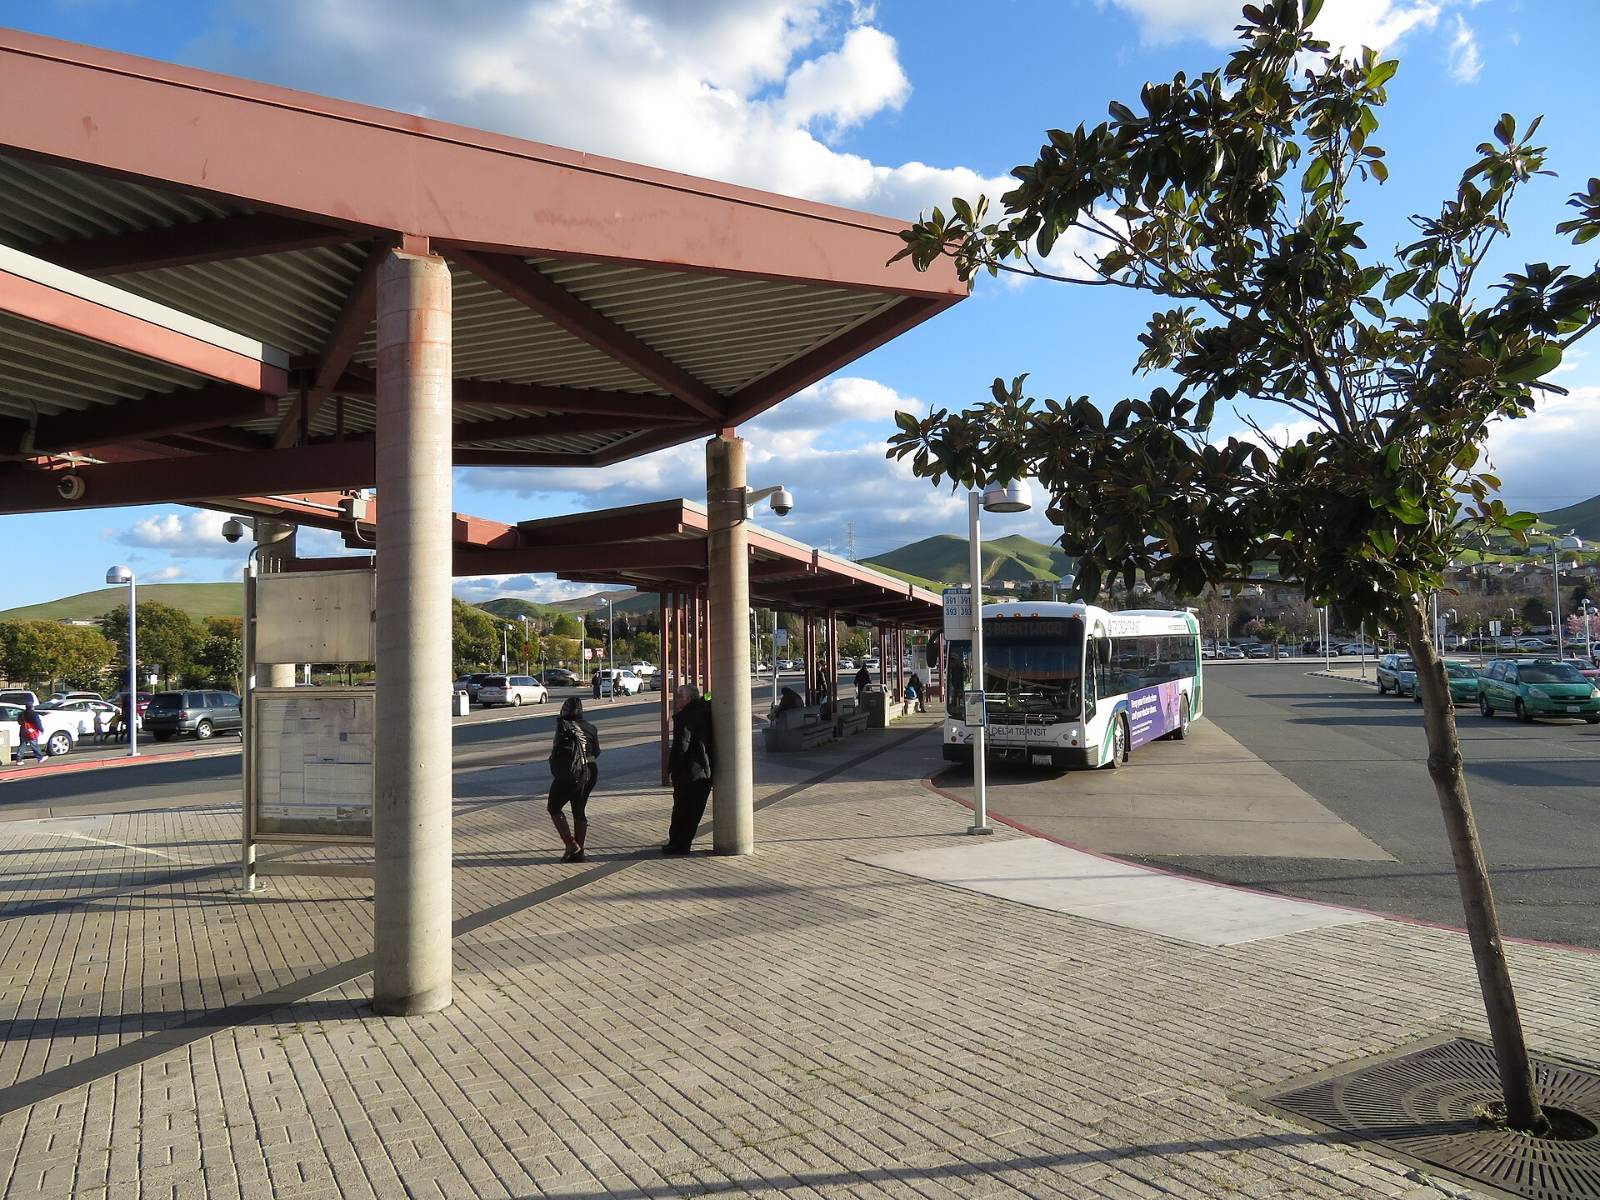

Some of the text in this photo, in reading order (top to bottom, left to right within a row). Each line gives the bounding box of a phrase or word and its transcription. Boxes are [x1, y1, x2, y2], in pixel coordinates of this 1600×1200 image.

[945, 608, 972, 616] 393 393
[992, 727, 1047, 736] DELTA TRANSIT
